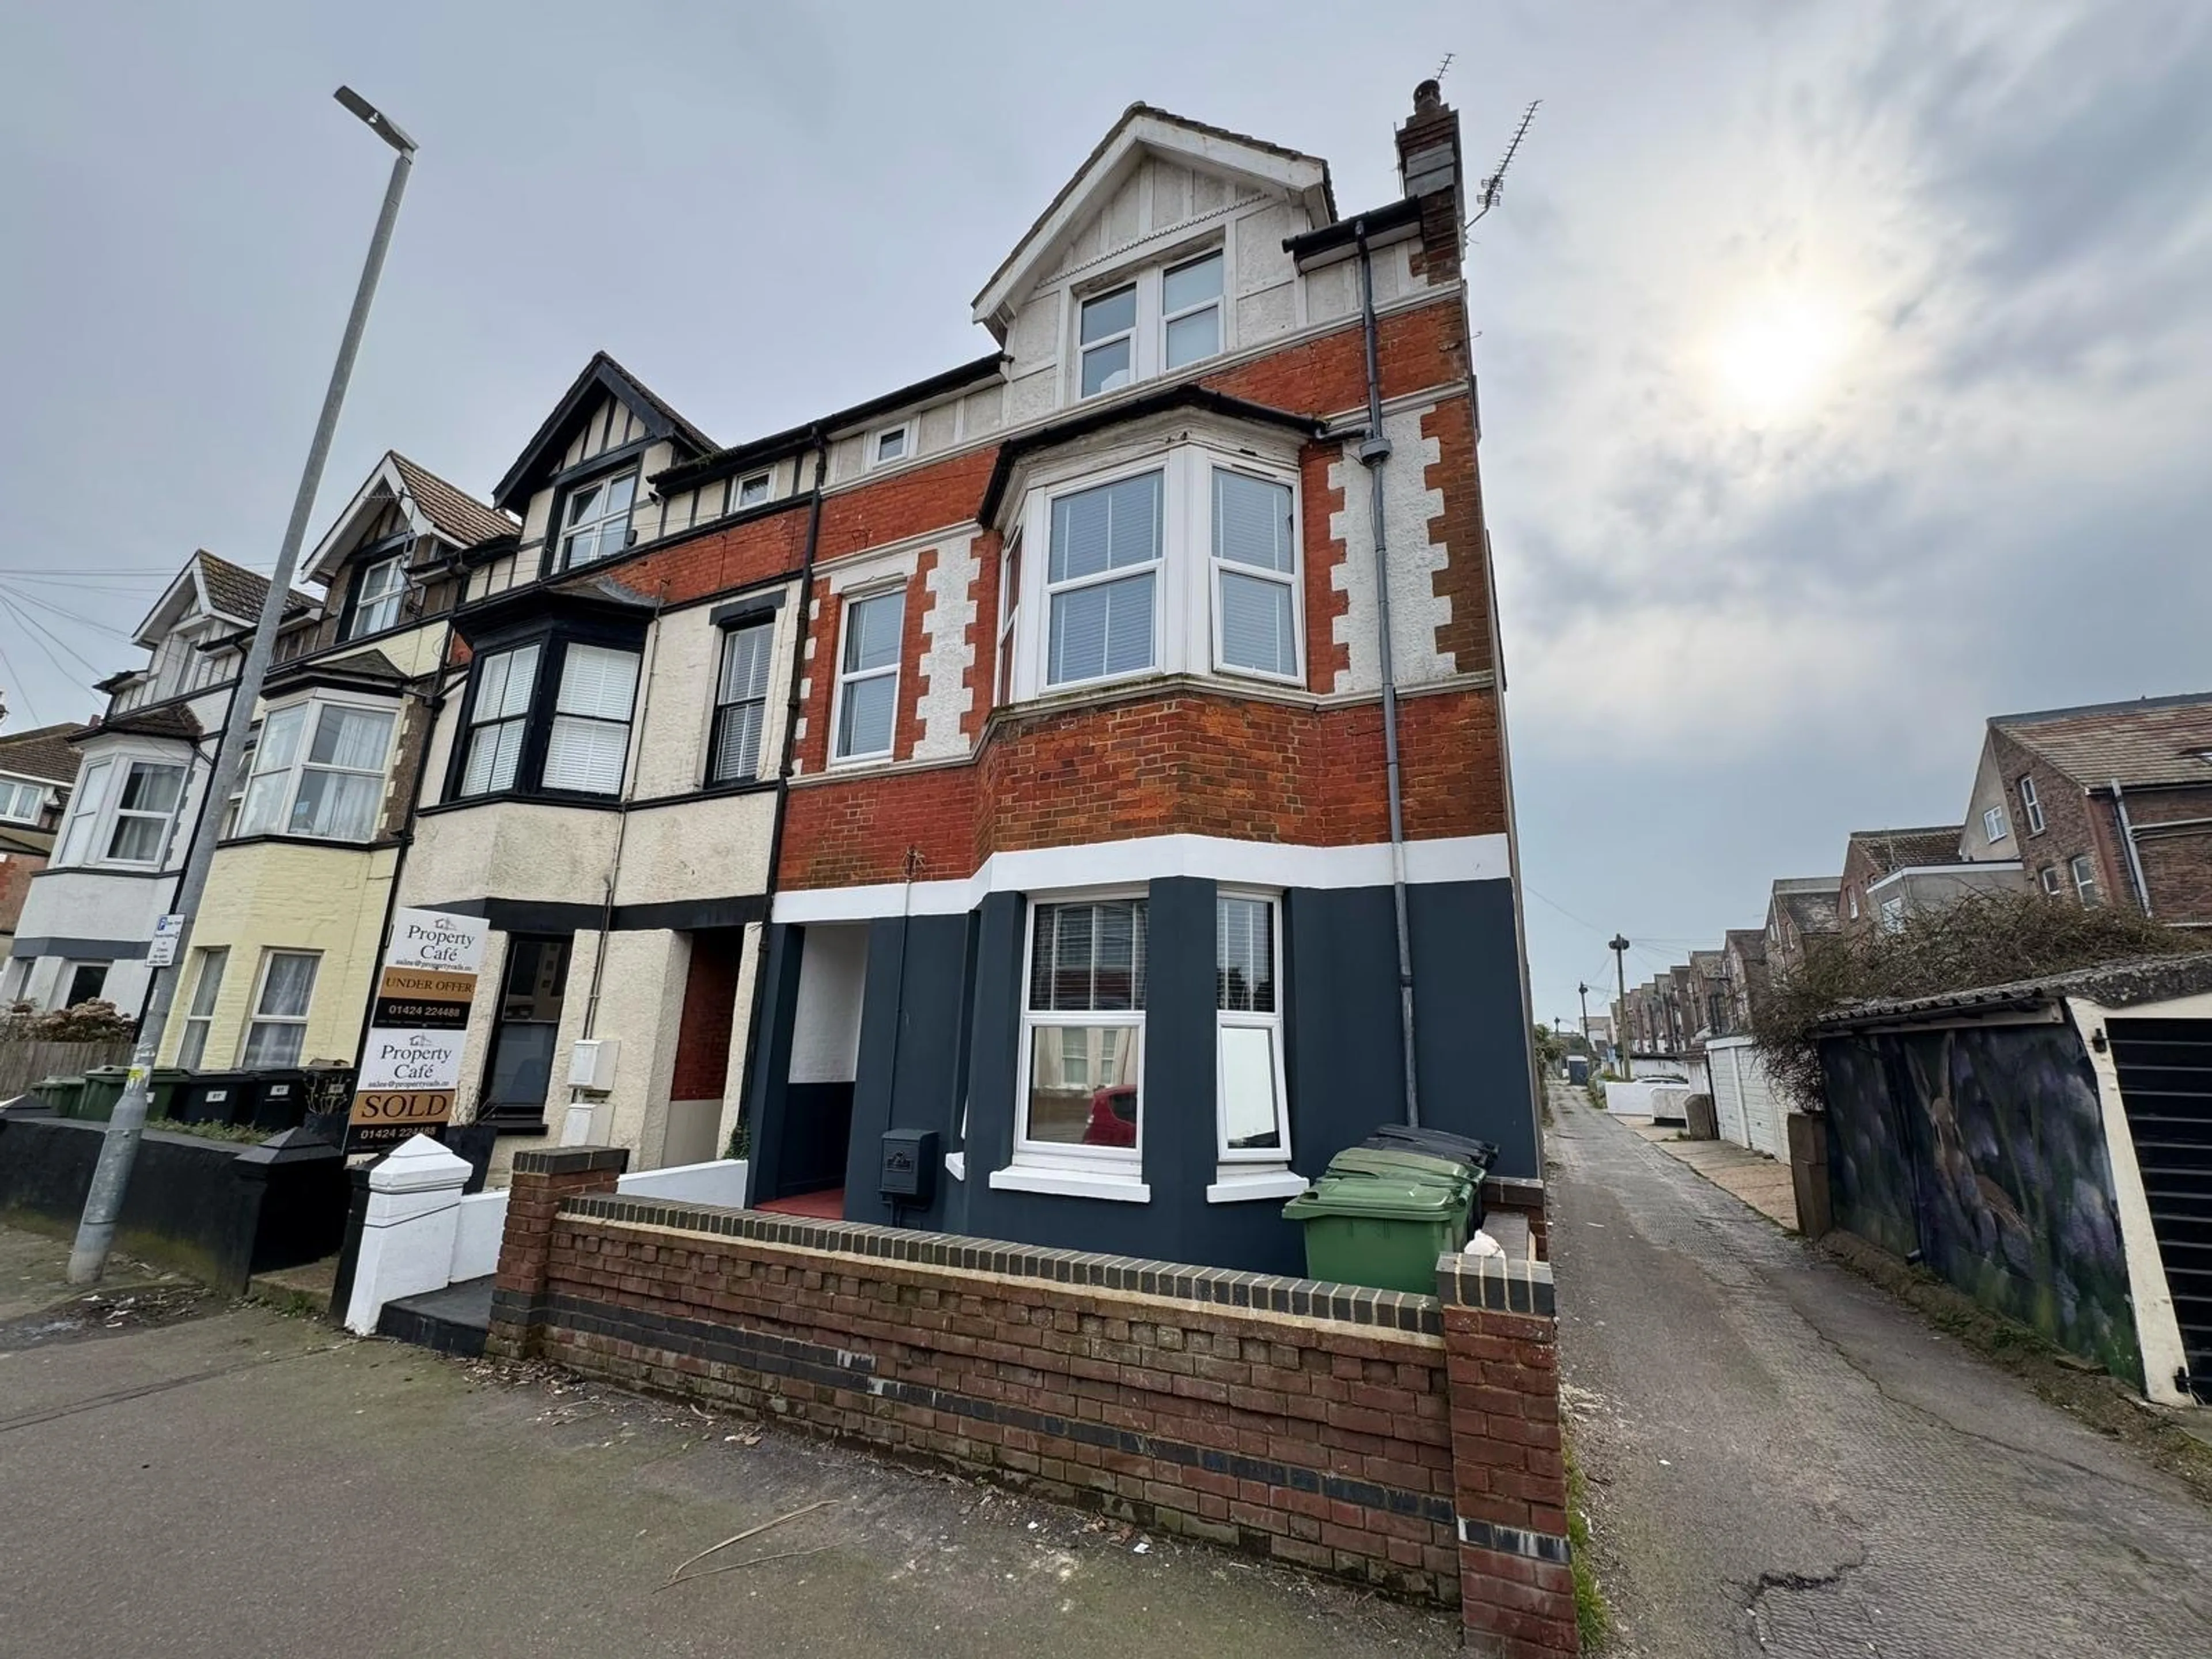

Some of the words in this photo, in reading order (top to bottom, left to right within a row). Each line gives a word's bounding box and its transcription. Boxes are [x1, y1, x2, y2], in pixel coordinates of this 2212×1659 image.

[408, 925, 475, 948] Property
[421, 945, 458, 961] Café
[386, 977, 432, 990] UNDER
[389, 1005, 422, 1016] 01424
[425, 1006, 460, 1017] 224488
[381, 1045, 452, 1063] Property
[394, 1064, 434, 1078] Café
[362, 1094, 446, 1118] SOLD
[361, 1128, 396, 1139] 01424
